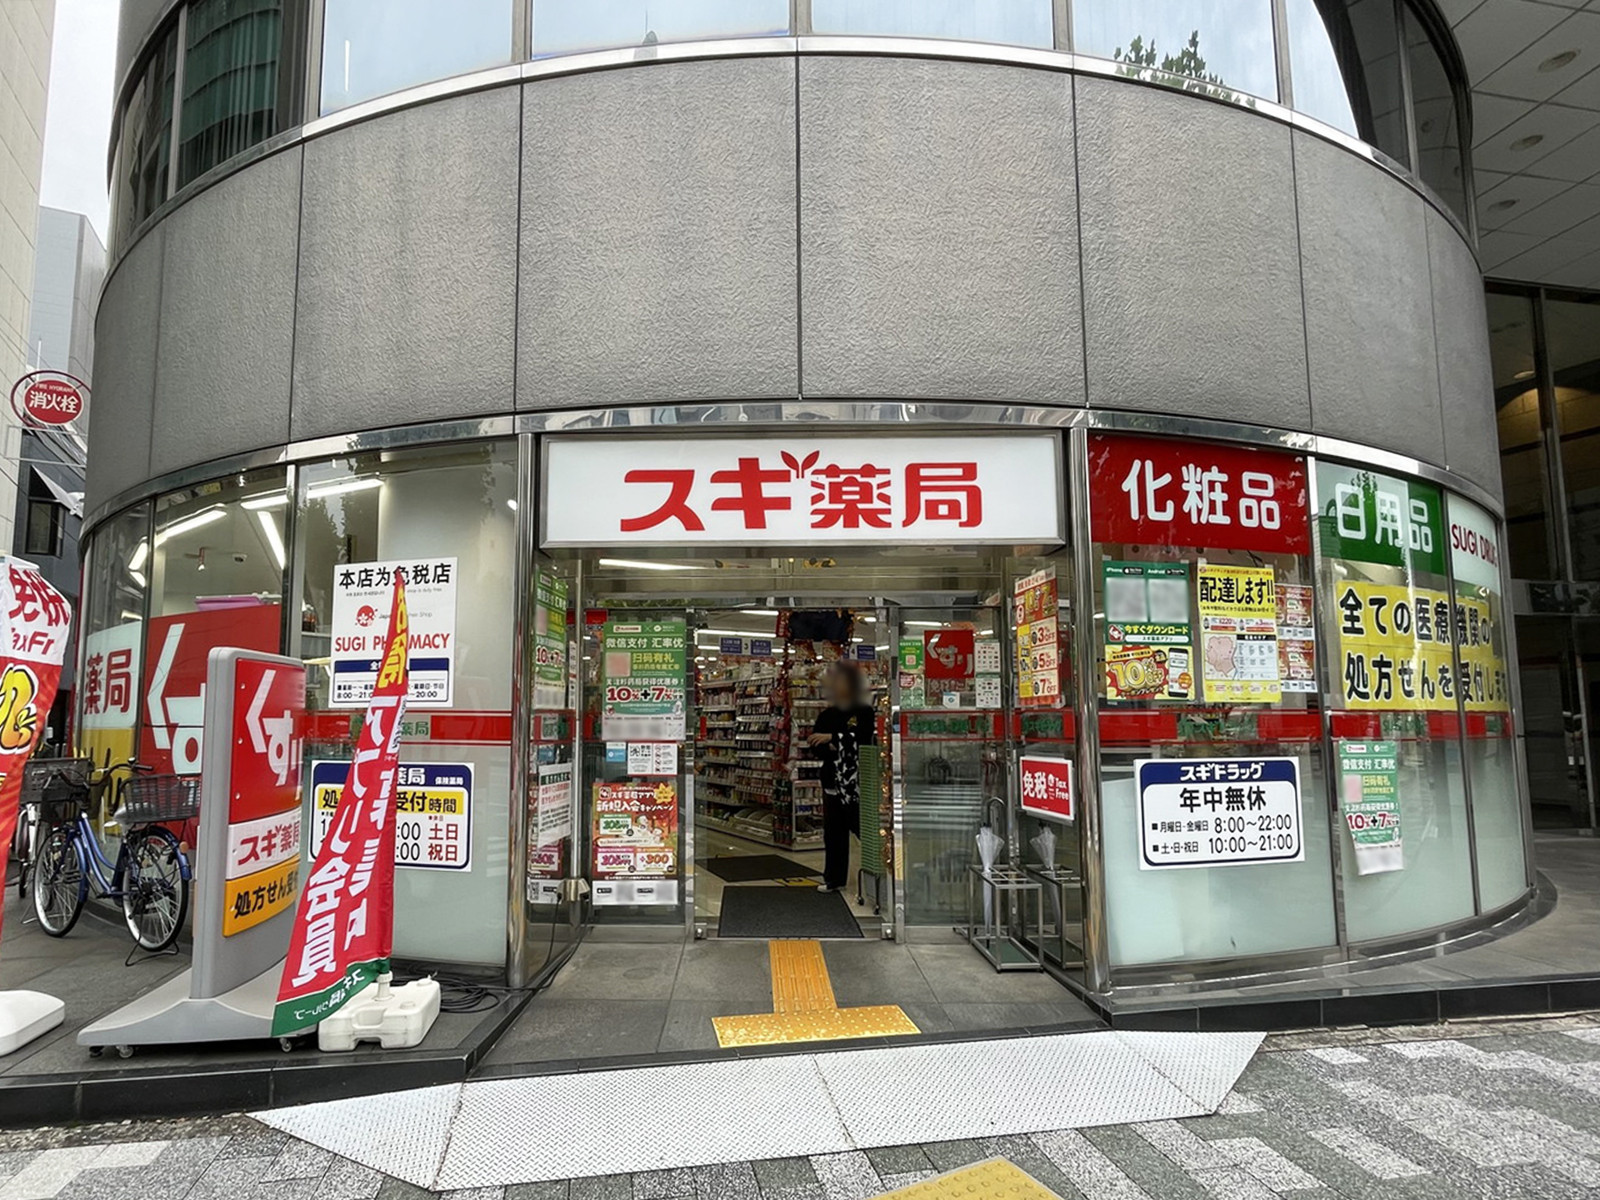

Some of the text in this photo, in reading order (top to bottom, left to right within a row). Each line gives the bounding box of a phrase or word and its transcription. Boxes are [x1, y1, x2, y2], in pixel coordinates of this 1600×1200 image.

[29, 390, 79, 414] 消火栓
[620, 450, 983, 532] スギ薬局
[1121, 458, 1281, 530] 化粧品
[1335, 482, 1433, 553] 日用品
[1451, 523, 1479, 557] SUGI
[1124, 624, 1189, 635] 今すぐダウンロード
[335, 633, 450, 652] SUGI PHMACY
[606, 638, 647, 648] 微信支付
[1179, 762, 1265, 782] スギドラッグ
[1023, 769, 1068, 800] 免税 Tax
[1055, 788, 1070, 801] Free
[596, 800, 674, 812] 新規入会キャンペーン
[1179, 785, 1267, 813] 年中無休
[428, 823, 459, 841] 土日
[1214, 814, 1293, 834] 8:00～22:00
[427, 844, 459, 862] 祝日
[1208, 833, 1294, 854] 10:00～21:00
